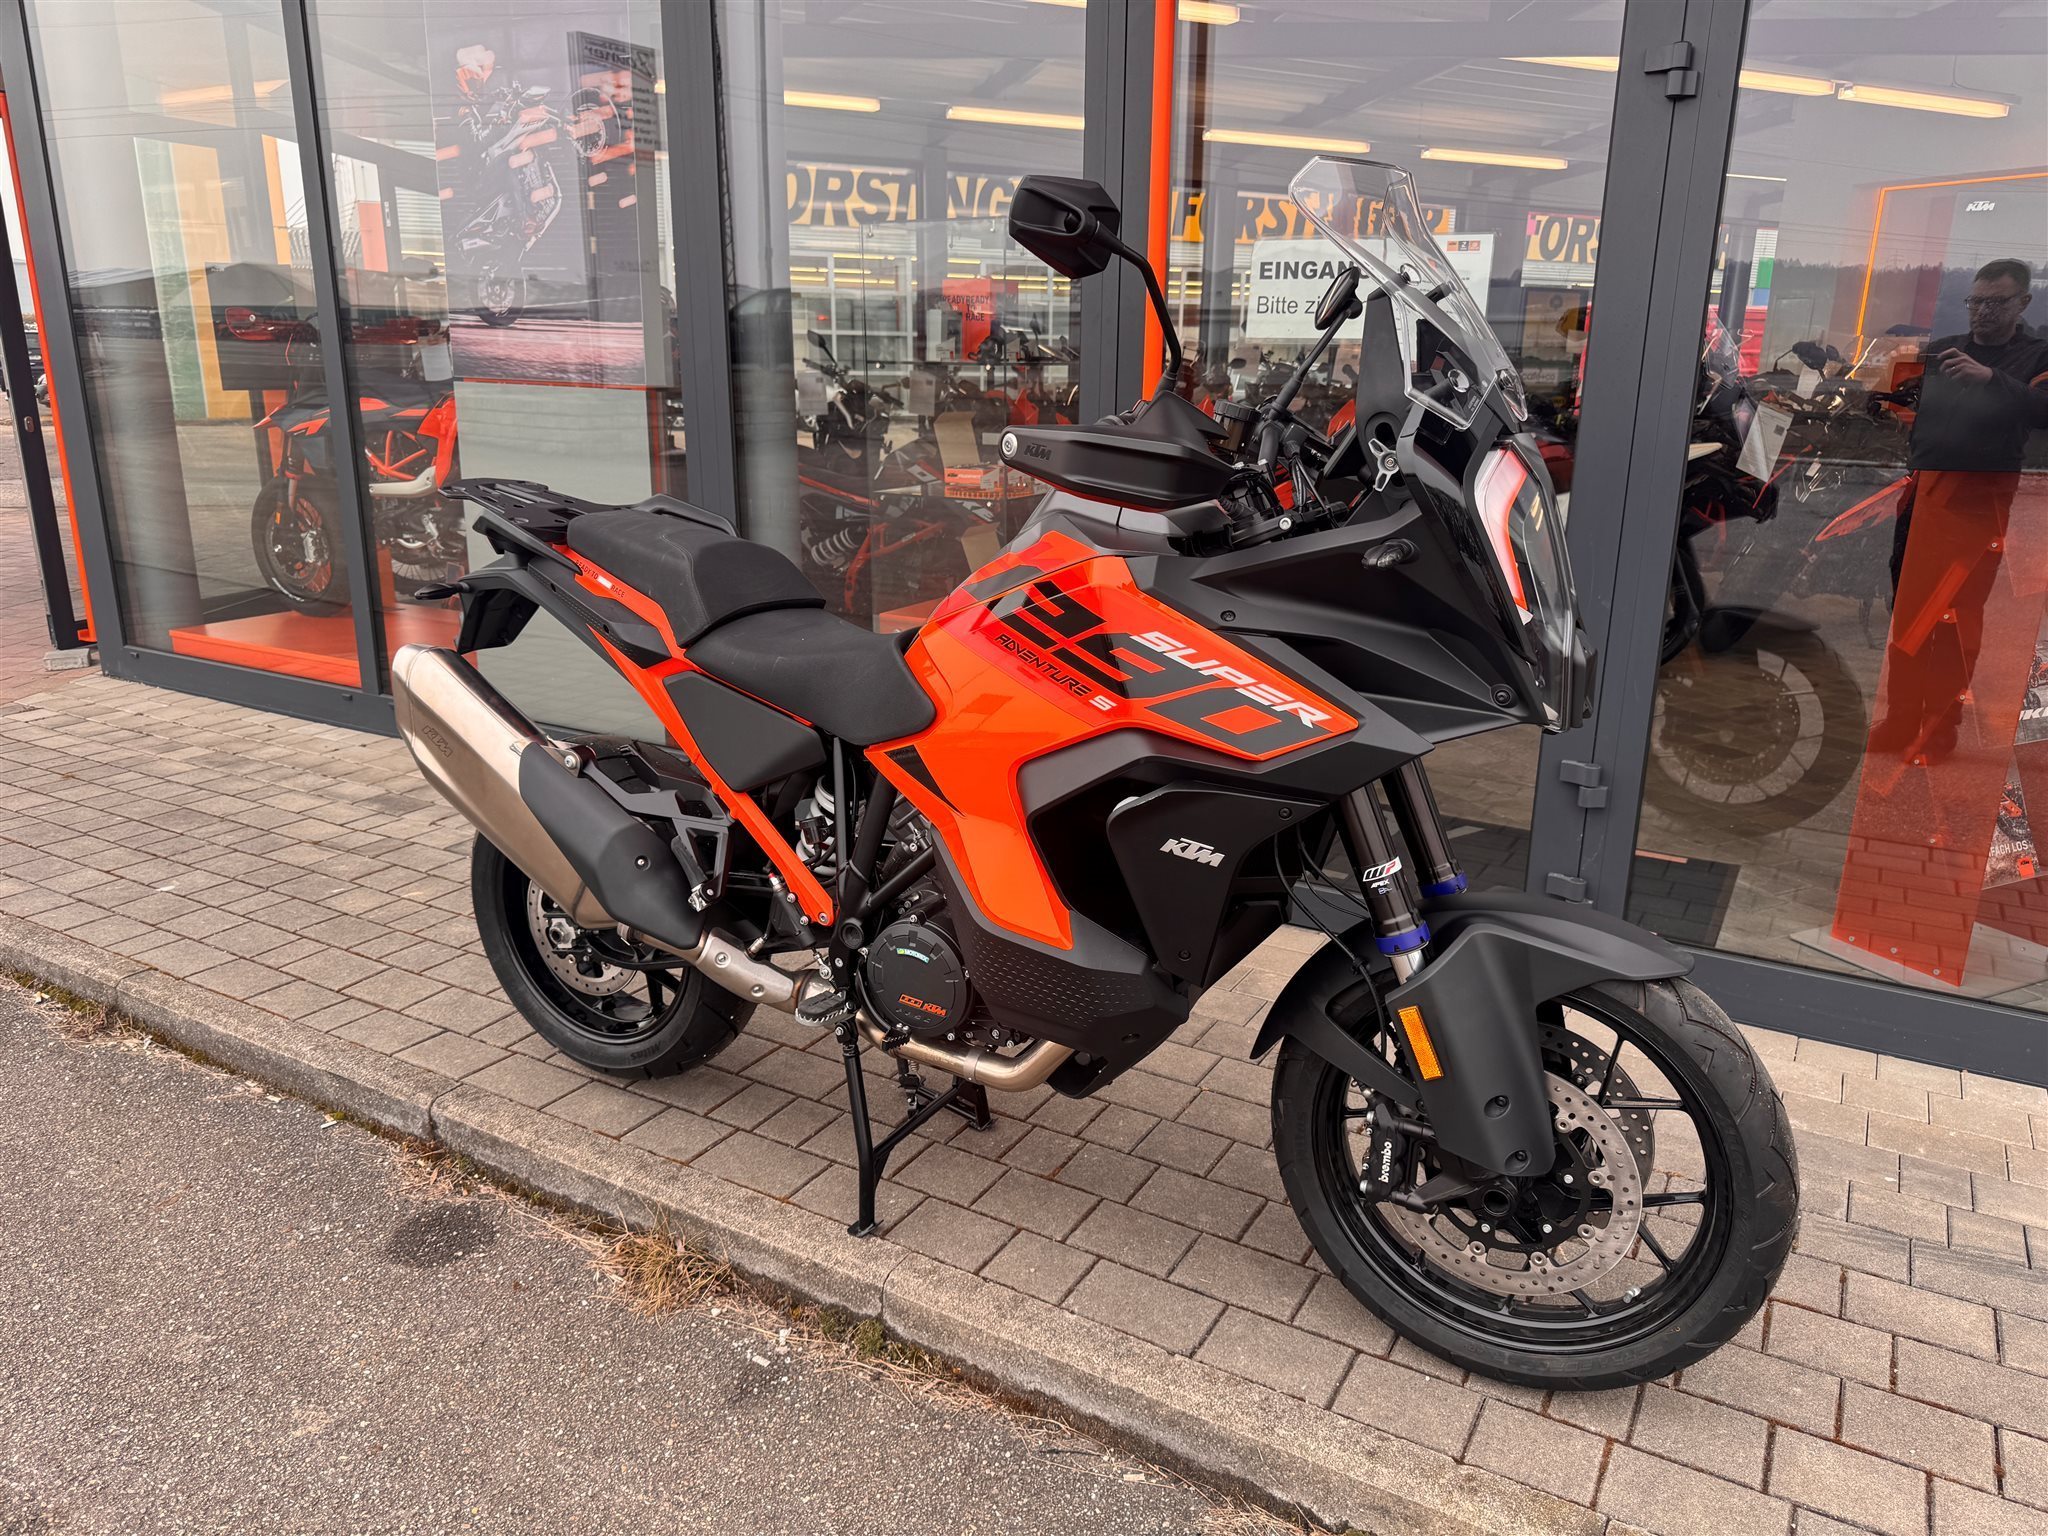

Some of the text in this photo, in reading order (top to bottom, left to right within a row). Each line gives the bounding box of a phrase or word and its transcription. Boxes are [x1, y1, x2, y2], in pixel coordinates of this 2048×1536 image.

[1966, 200, 1995, 211] KTM
[1256, 295, 1298, 314] Bitte
[1024, 443, 1052, 461] KTM
[611, 585, 625, 598] RACE
[995, 633, 1118, 711] ADVENTURE S
[1130, 631, 1332, 729] SUPER
[422, 725, 453, 757] KTM
[1160, 838, 1226, 867] KTM
[923, 1003, 946, 1017] KTM
[1378, 1141, 1392, 1183] brembo
